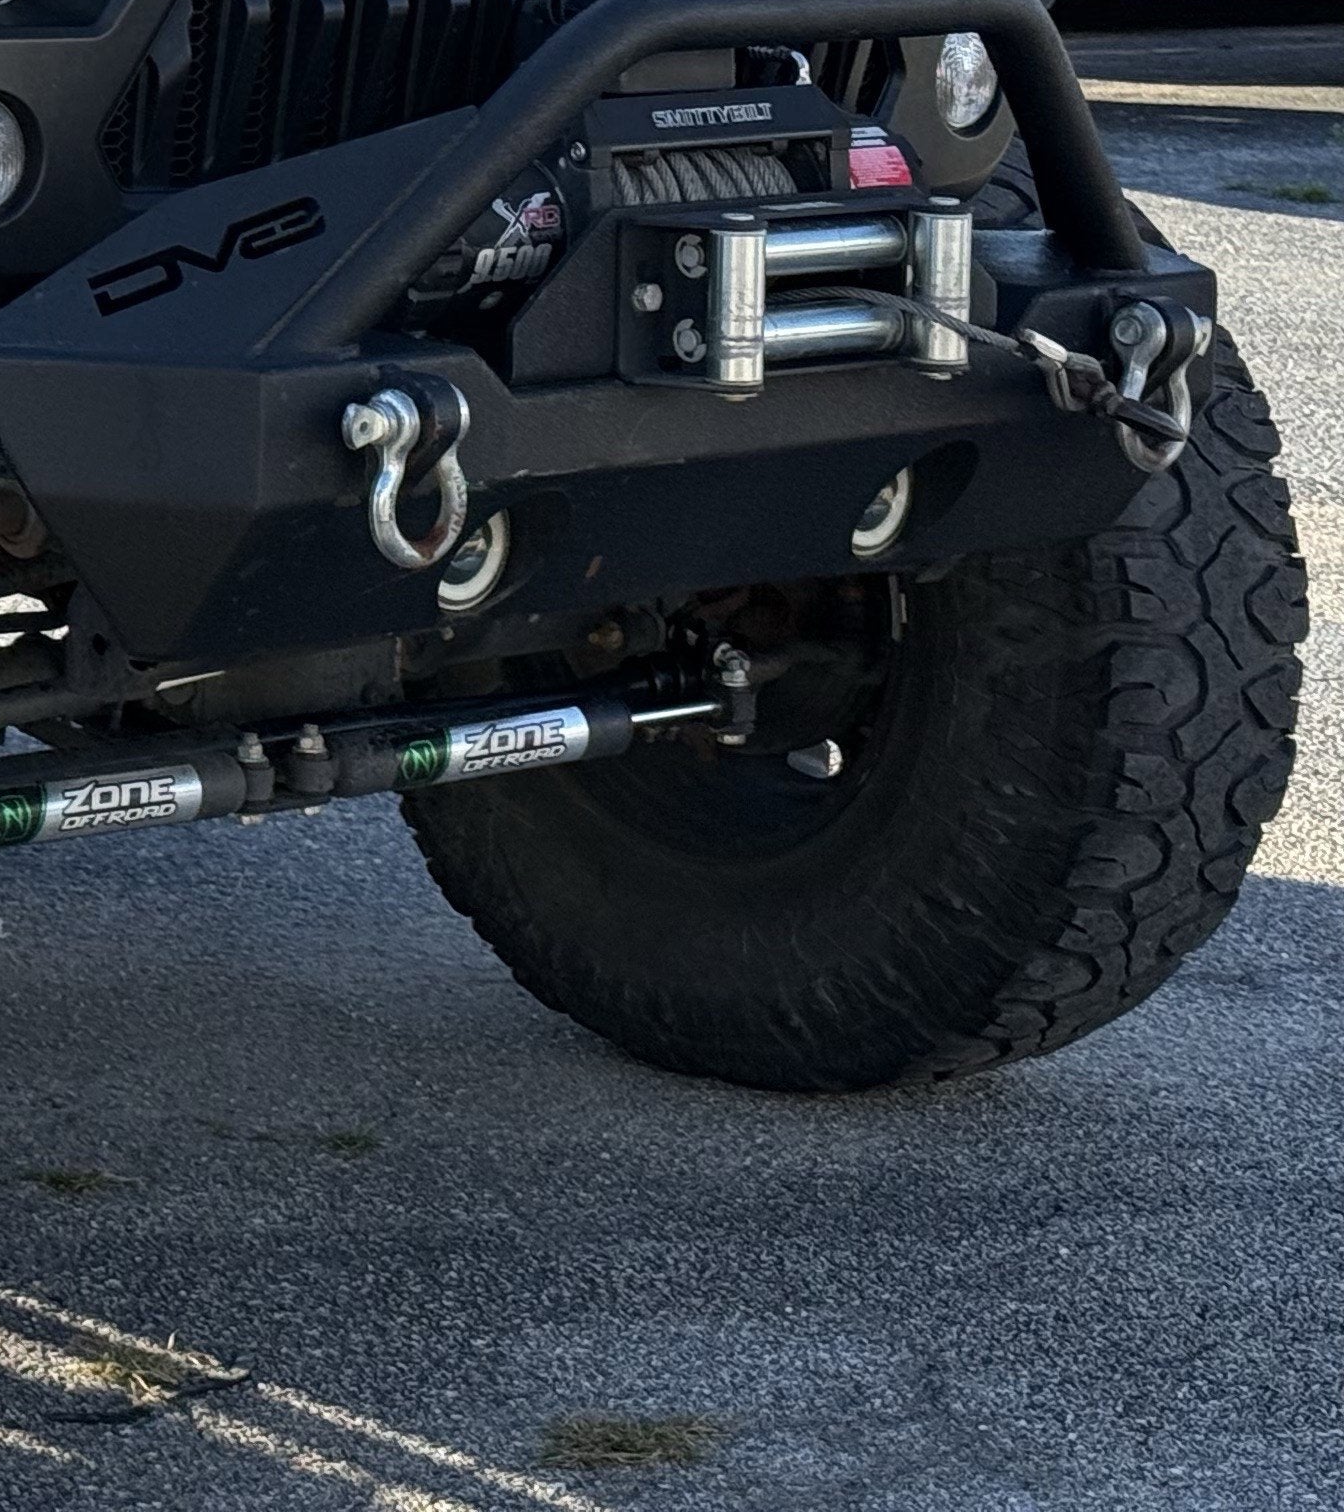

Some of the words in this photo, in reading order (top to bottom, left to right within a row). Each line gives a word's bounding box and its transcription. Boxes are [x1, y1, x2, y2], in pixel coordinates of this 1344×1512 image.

[652, 102, 772, 128] SMITTYBILT
[464, 719, 565, 759] ZONE
[463, 744, 566, 773] OFFROAD
[63, 776, 176, 814] ZONE
[61, 803, 177, 831] OFFROAD
